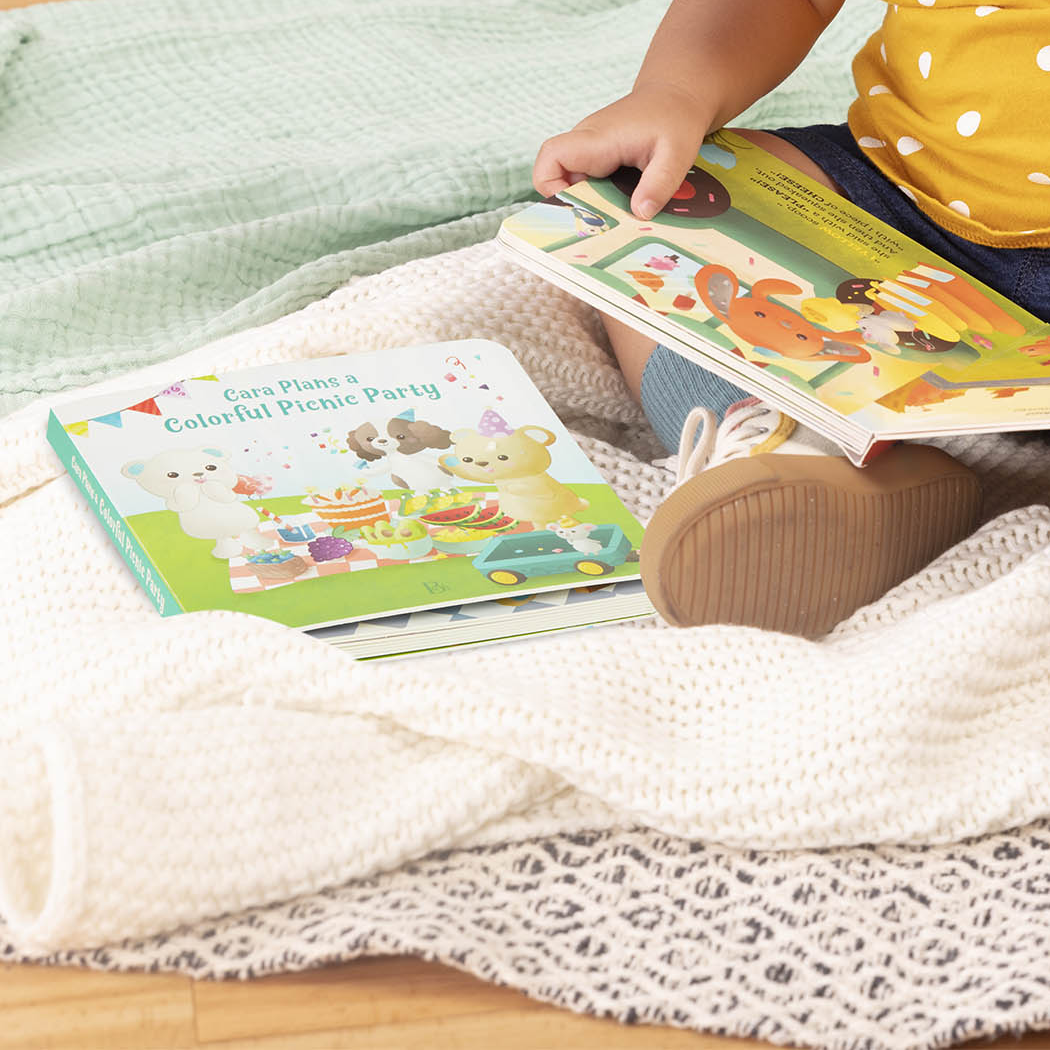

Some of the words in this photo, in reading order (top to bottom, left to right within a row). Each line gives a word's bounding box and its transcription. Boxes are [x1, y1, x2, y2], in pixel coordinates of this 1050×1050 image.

[775, 181, 827, 211] squeaked
[823, 202, 838, 210] of
[821, 216, 845, 233] with
[839, 210, 870, 228] piece
[845, 232, 870, 247] said
[848, 223, 873, 240] then
[873, 239, 899, 254] And
[222, 385, 275, 402] Cara
[277, 375, 340, 394] Plans
[346, 374, 359, 384] a
[164, 403, 273, 433] Colorful
[276, 393, 359, 416] Picnic
[362, 382, 442, 404] Party
[100, 498, 126, 548] Colorful
[126, 536, 145, 579] Picnic
[145, 567, 165, 615] Party
